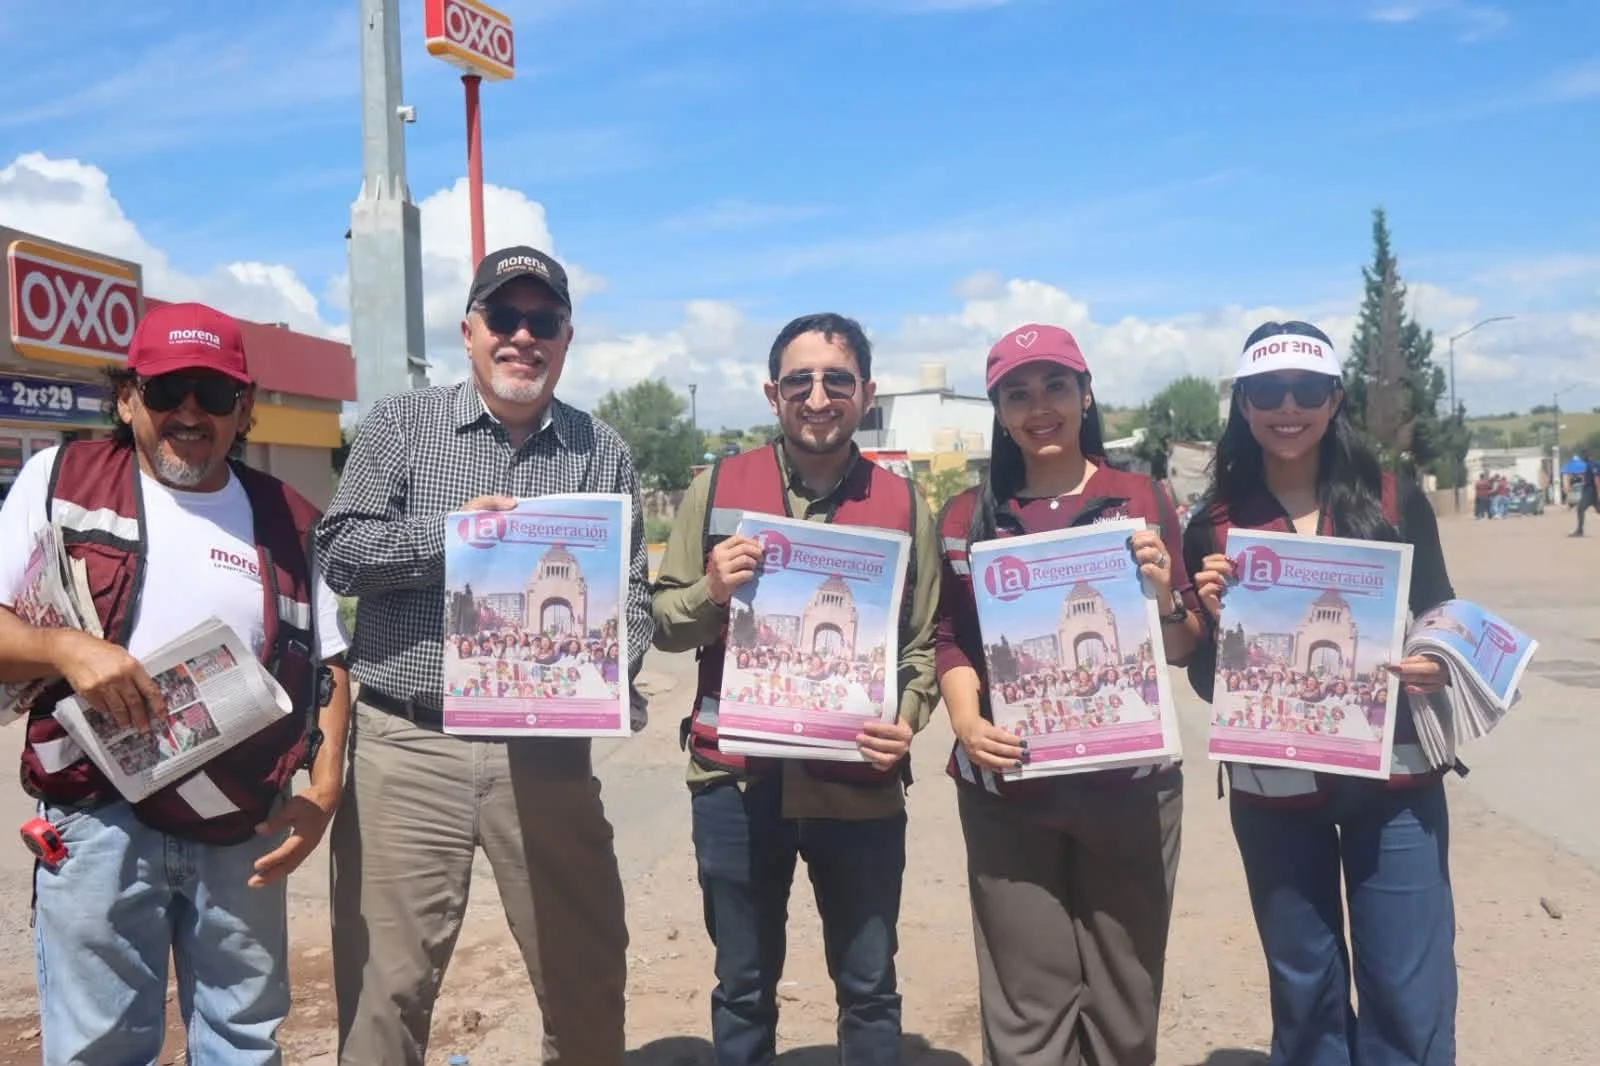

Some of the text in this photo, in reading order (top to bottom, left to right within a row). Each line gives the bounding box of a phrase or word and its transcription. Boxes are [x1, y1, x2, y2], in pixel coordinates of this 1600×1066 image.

[446, 3, 512, 62] OXXO
[496, 255, 548, 273] morena
[21, 271, 135, 347] OXXO
[169, 329, 220, 345] morena
[1252, 340, 1323, 362] morena
[509, 518, 608, 540] Regeneración
[211, 548, 261, 577] more
[792, 549, 884, 574] Regeneración
[1031, 556, 1127, 582] Regeneración
[1284, 563, 1384, 585] Regeneración
